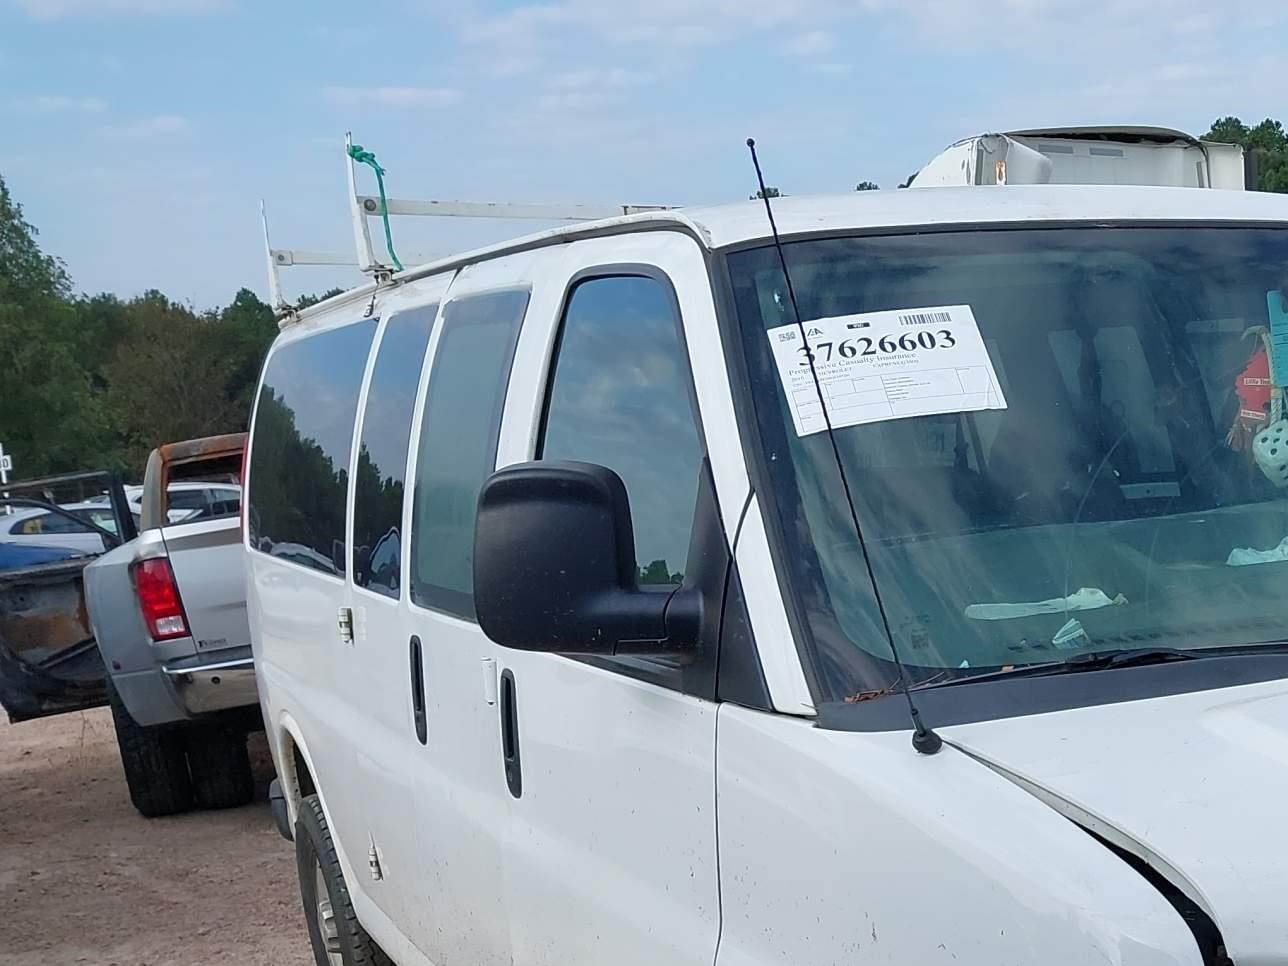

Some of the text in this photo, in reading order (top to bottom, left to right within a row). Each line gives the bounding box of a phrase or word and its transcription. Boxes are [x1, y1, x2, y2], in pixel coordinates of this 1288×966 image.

[796, 329, 956, 367] 37626603
[838, 355, 875, 369] Casualty
[876, 352, 917, 363] Insurance
